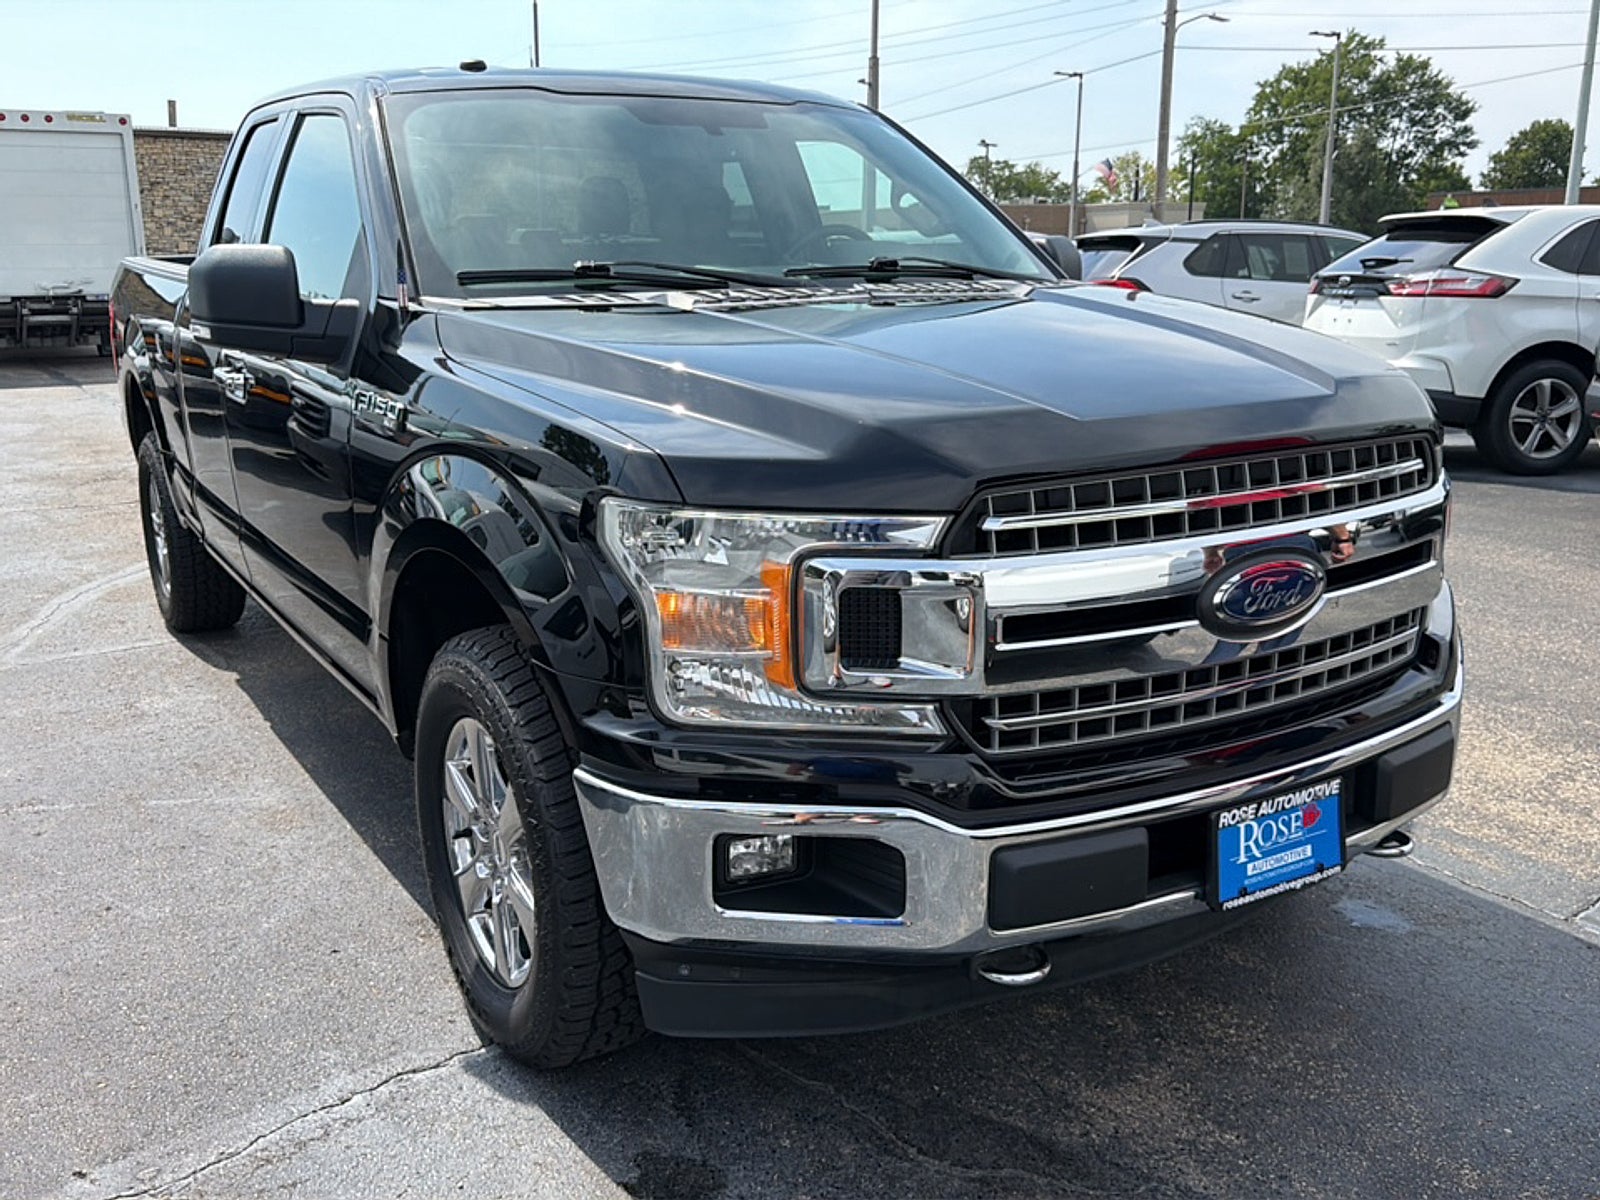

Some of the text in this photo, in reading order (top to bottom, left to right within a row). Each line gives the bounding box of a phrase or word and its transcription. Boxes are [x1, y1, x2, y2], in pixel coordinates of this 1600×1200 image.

[1244, 575, 1302, 614] Ford
[1219, 779, 1341, 828] ROSE AUTOMOTIVE
[1249, 846, 1309, 873] AUTOMOTIVE
